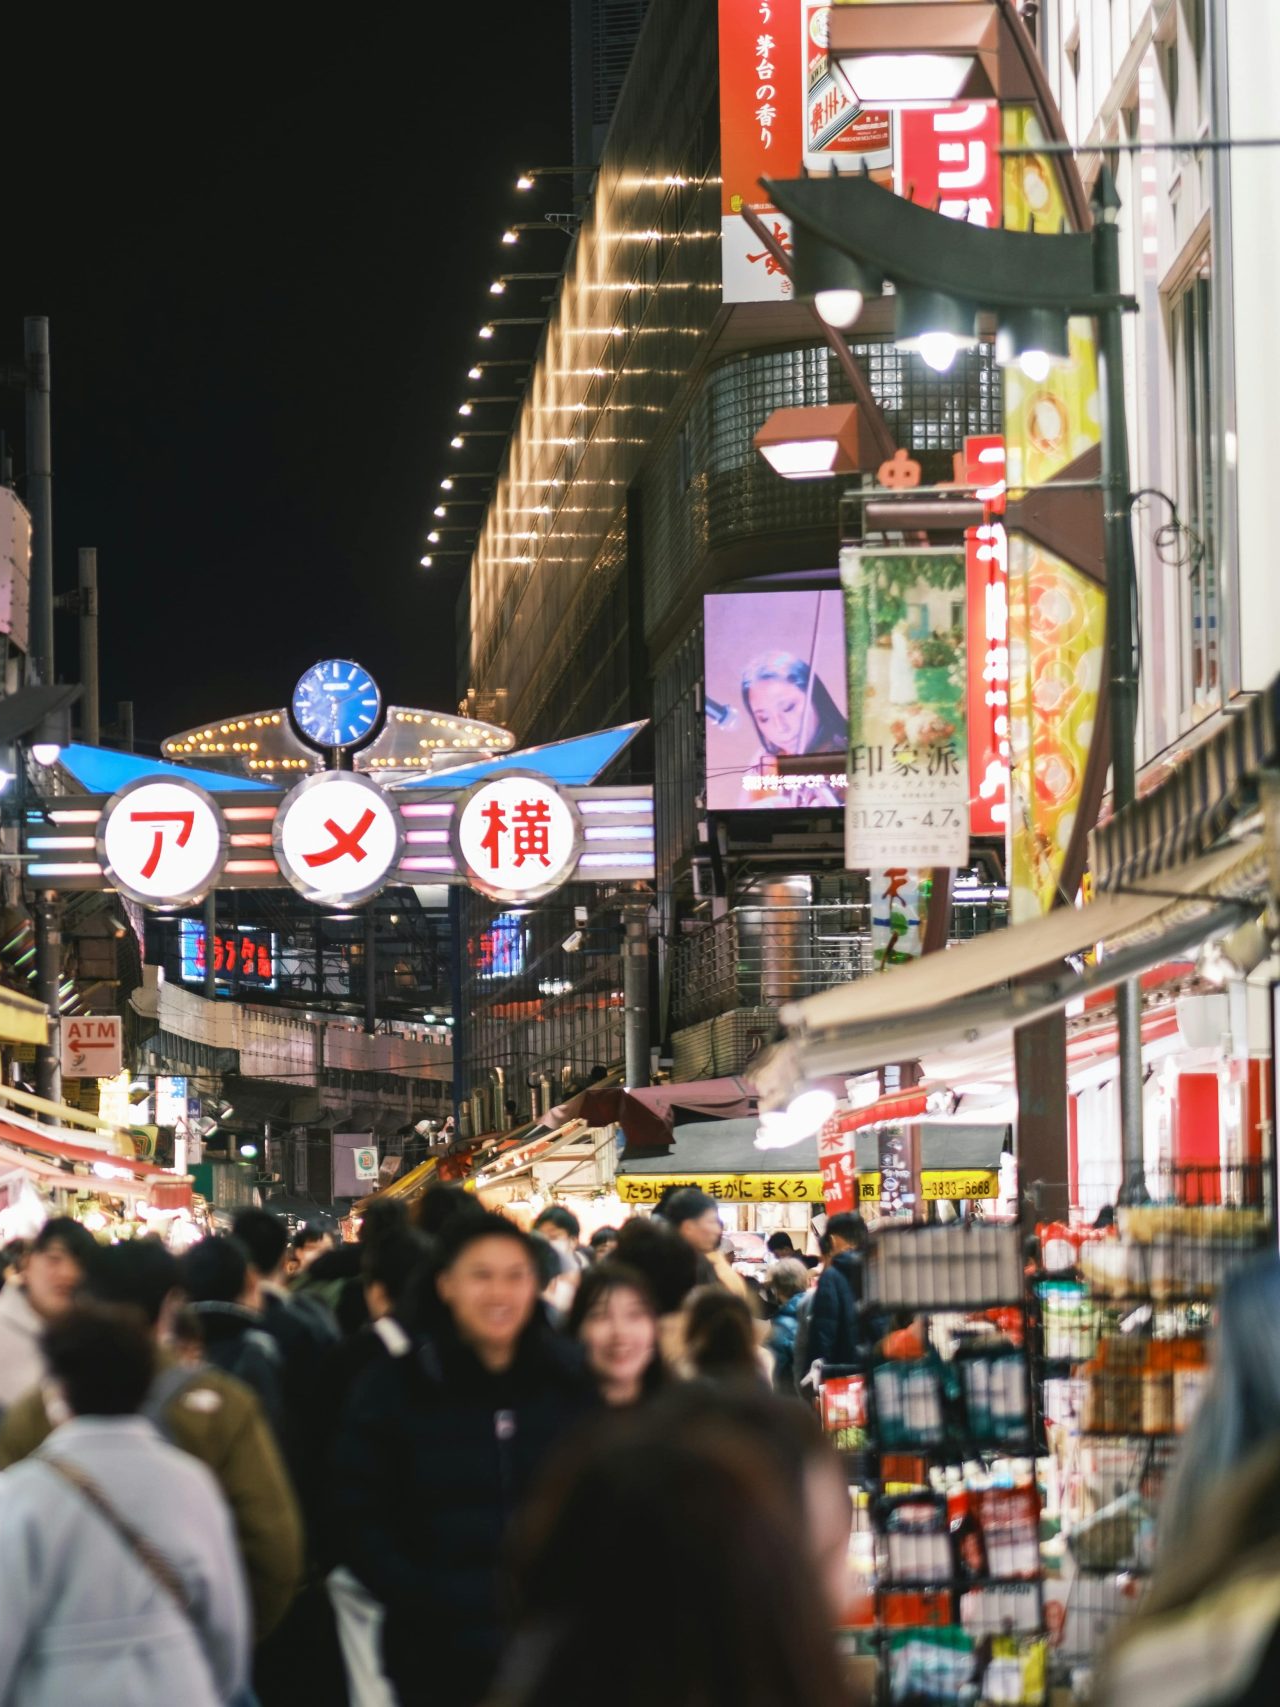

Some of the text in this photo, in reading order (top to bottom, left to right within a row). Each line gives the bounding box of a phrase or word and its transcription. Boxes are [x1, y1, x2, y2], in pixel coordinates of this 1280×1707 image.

[755, 34, 777, 150] 茅台の香り
[850, 743, 959, 776] 印象派
[130, 798, 552, 880] アメ横
[68, 1022, 115, 1038] ATM
[708, 1181, 752, 1199] 毛がに
[762, 1179, 808, 1198] まぐろ
